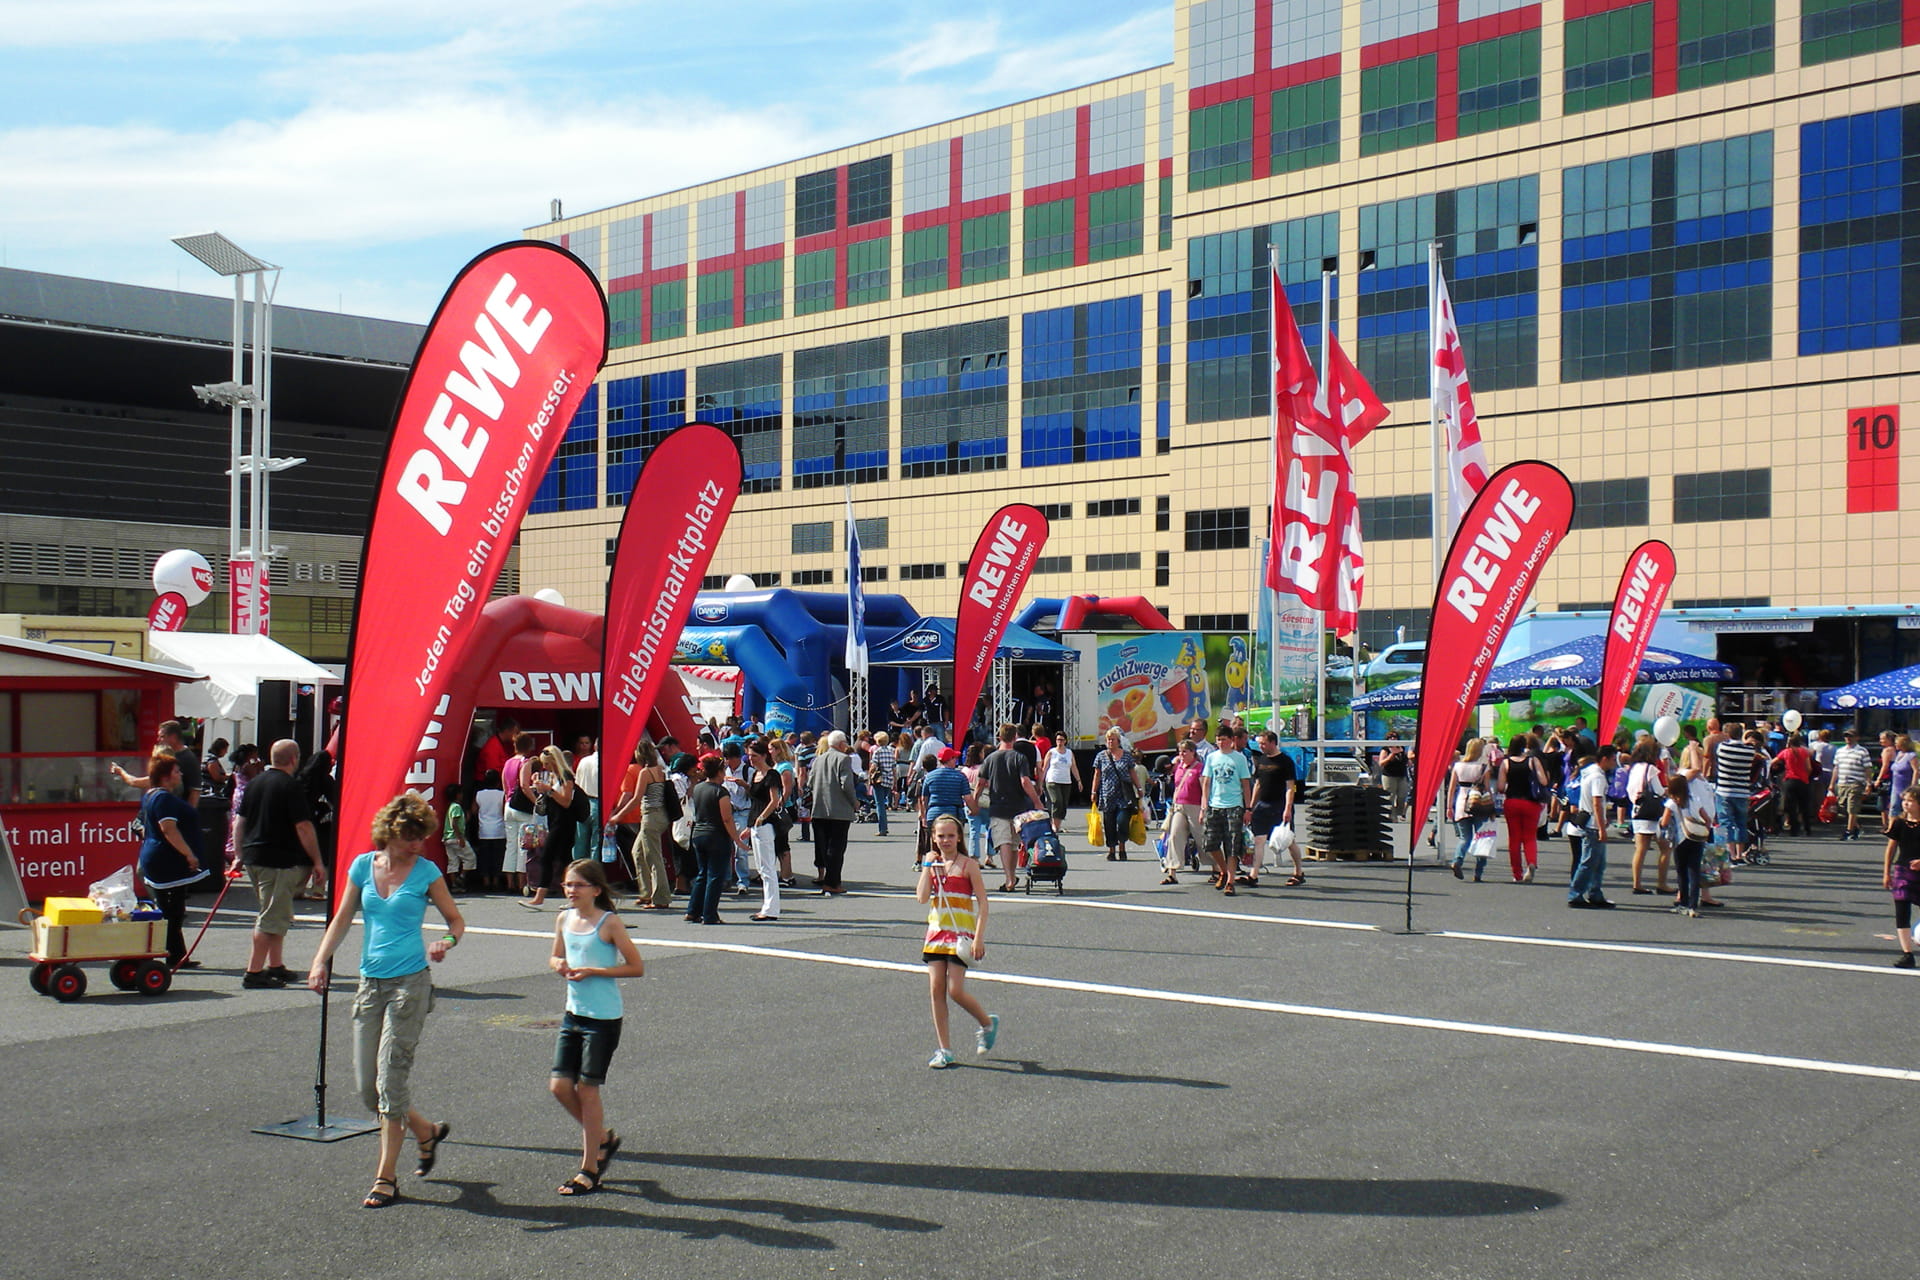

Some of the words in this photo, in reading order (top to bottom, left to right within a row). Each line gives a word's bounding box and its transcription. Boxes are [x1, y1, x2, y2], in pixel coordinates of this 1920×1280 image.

[396, 272, 553, 537] REWE
[1852, 413, 1896, 451] 10
[415, 624, 452, 696] Jeden
[443, 579, 476, 620] Tag
[466, 540, 493, 577] ein
[481, 445, 534, 538] bisschen
[527, 368, 576, 442] besser.
[969, 514, 1028, 609] REWE
[1015, 541, 1036, 570] besser.
[1447, 477, 1542, 625] REWE
[236, 566, 252, 634] EWE
[613, 479, 724, 717] Erlebnismarktplatz
[997, 572, 1021, 611] bisschen
[1614, 552, 1660, 643] REWE
[992, 609, 1004, 627] ein
[1456, 670, 1479, 710] Jeden
[1474, 645, 1492, 669] Tag
[1486, 623, 1501, 645] ein
[1495, 570, 1529, 630] bisschen
[1524, 529, 1553, 572] besser.
[1699, 621, 1738, 632] Herzlich
[1740, 620, 1804, 631] Willkommen
[676, 640, 703, 655] werge
[983, 628, 997, 645] Tag
[973, 645, 988, 673] Jeden
[1491, 681, 1509, 690] Der
[1509, 677, 1540, 689] Schatz
[1542, 676, 1559, 686] der
[1868, 696, 1891, 706] Der
[1893, 695, 1920, 706] Scha
[29, 822, 70, 845] mal
[20, 855, 85, 877] ieren!
